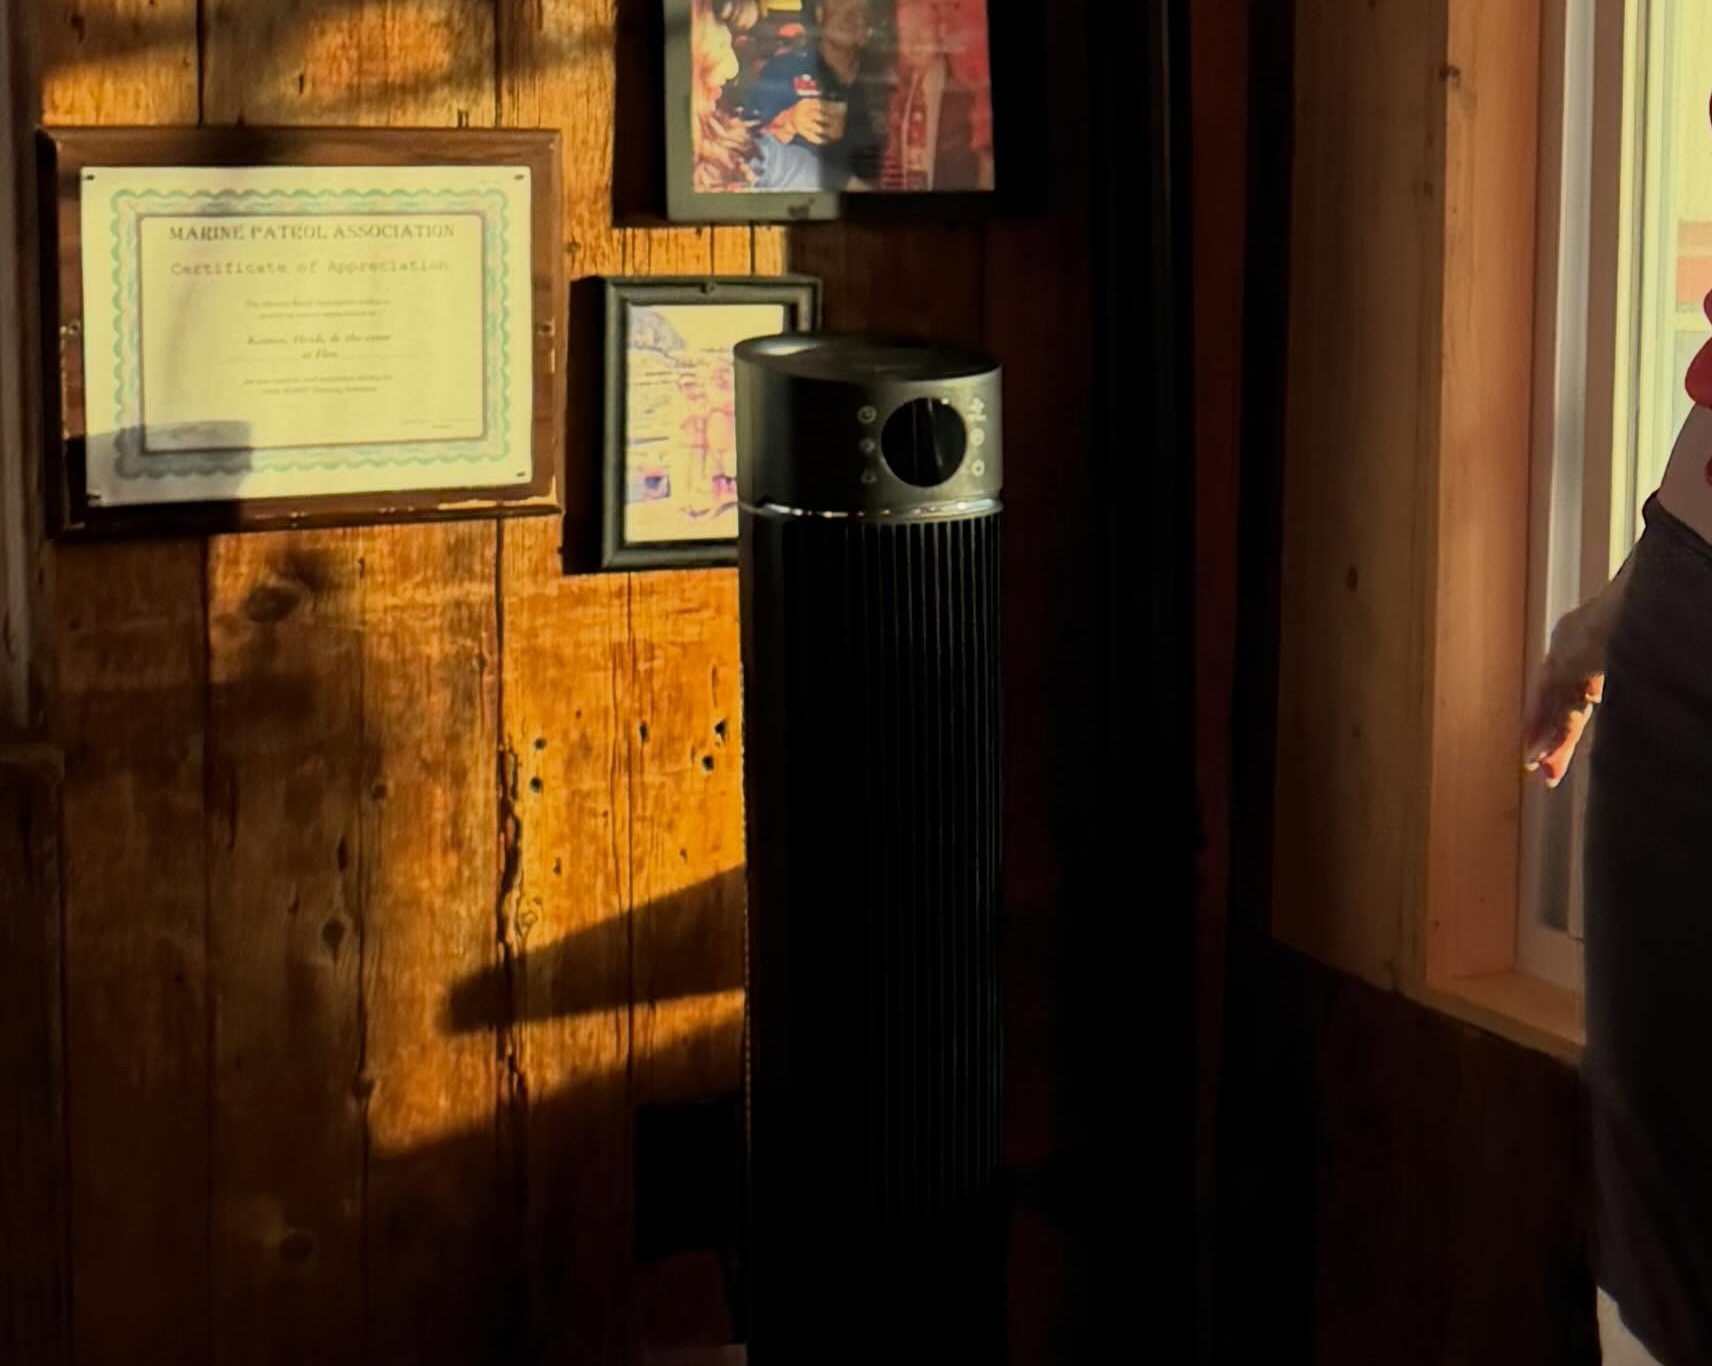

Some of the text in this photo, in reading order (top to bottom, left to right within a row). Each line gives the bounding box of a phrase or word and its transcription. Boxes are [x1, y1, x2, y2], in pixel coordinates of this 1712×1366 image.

[169, 223, 455, 241] MARINE PATROL ASSOCIATION
[170, 261, 288, 276] Certificate
[328, 259, 451, 276] Appreciation
